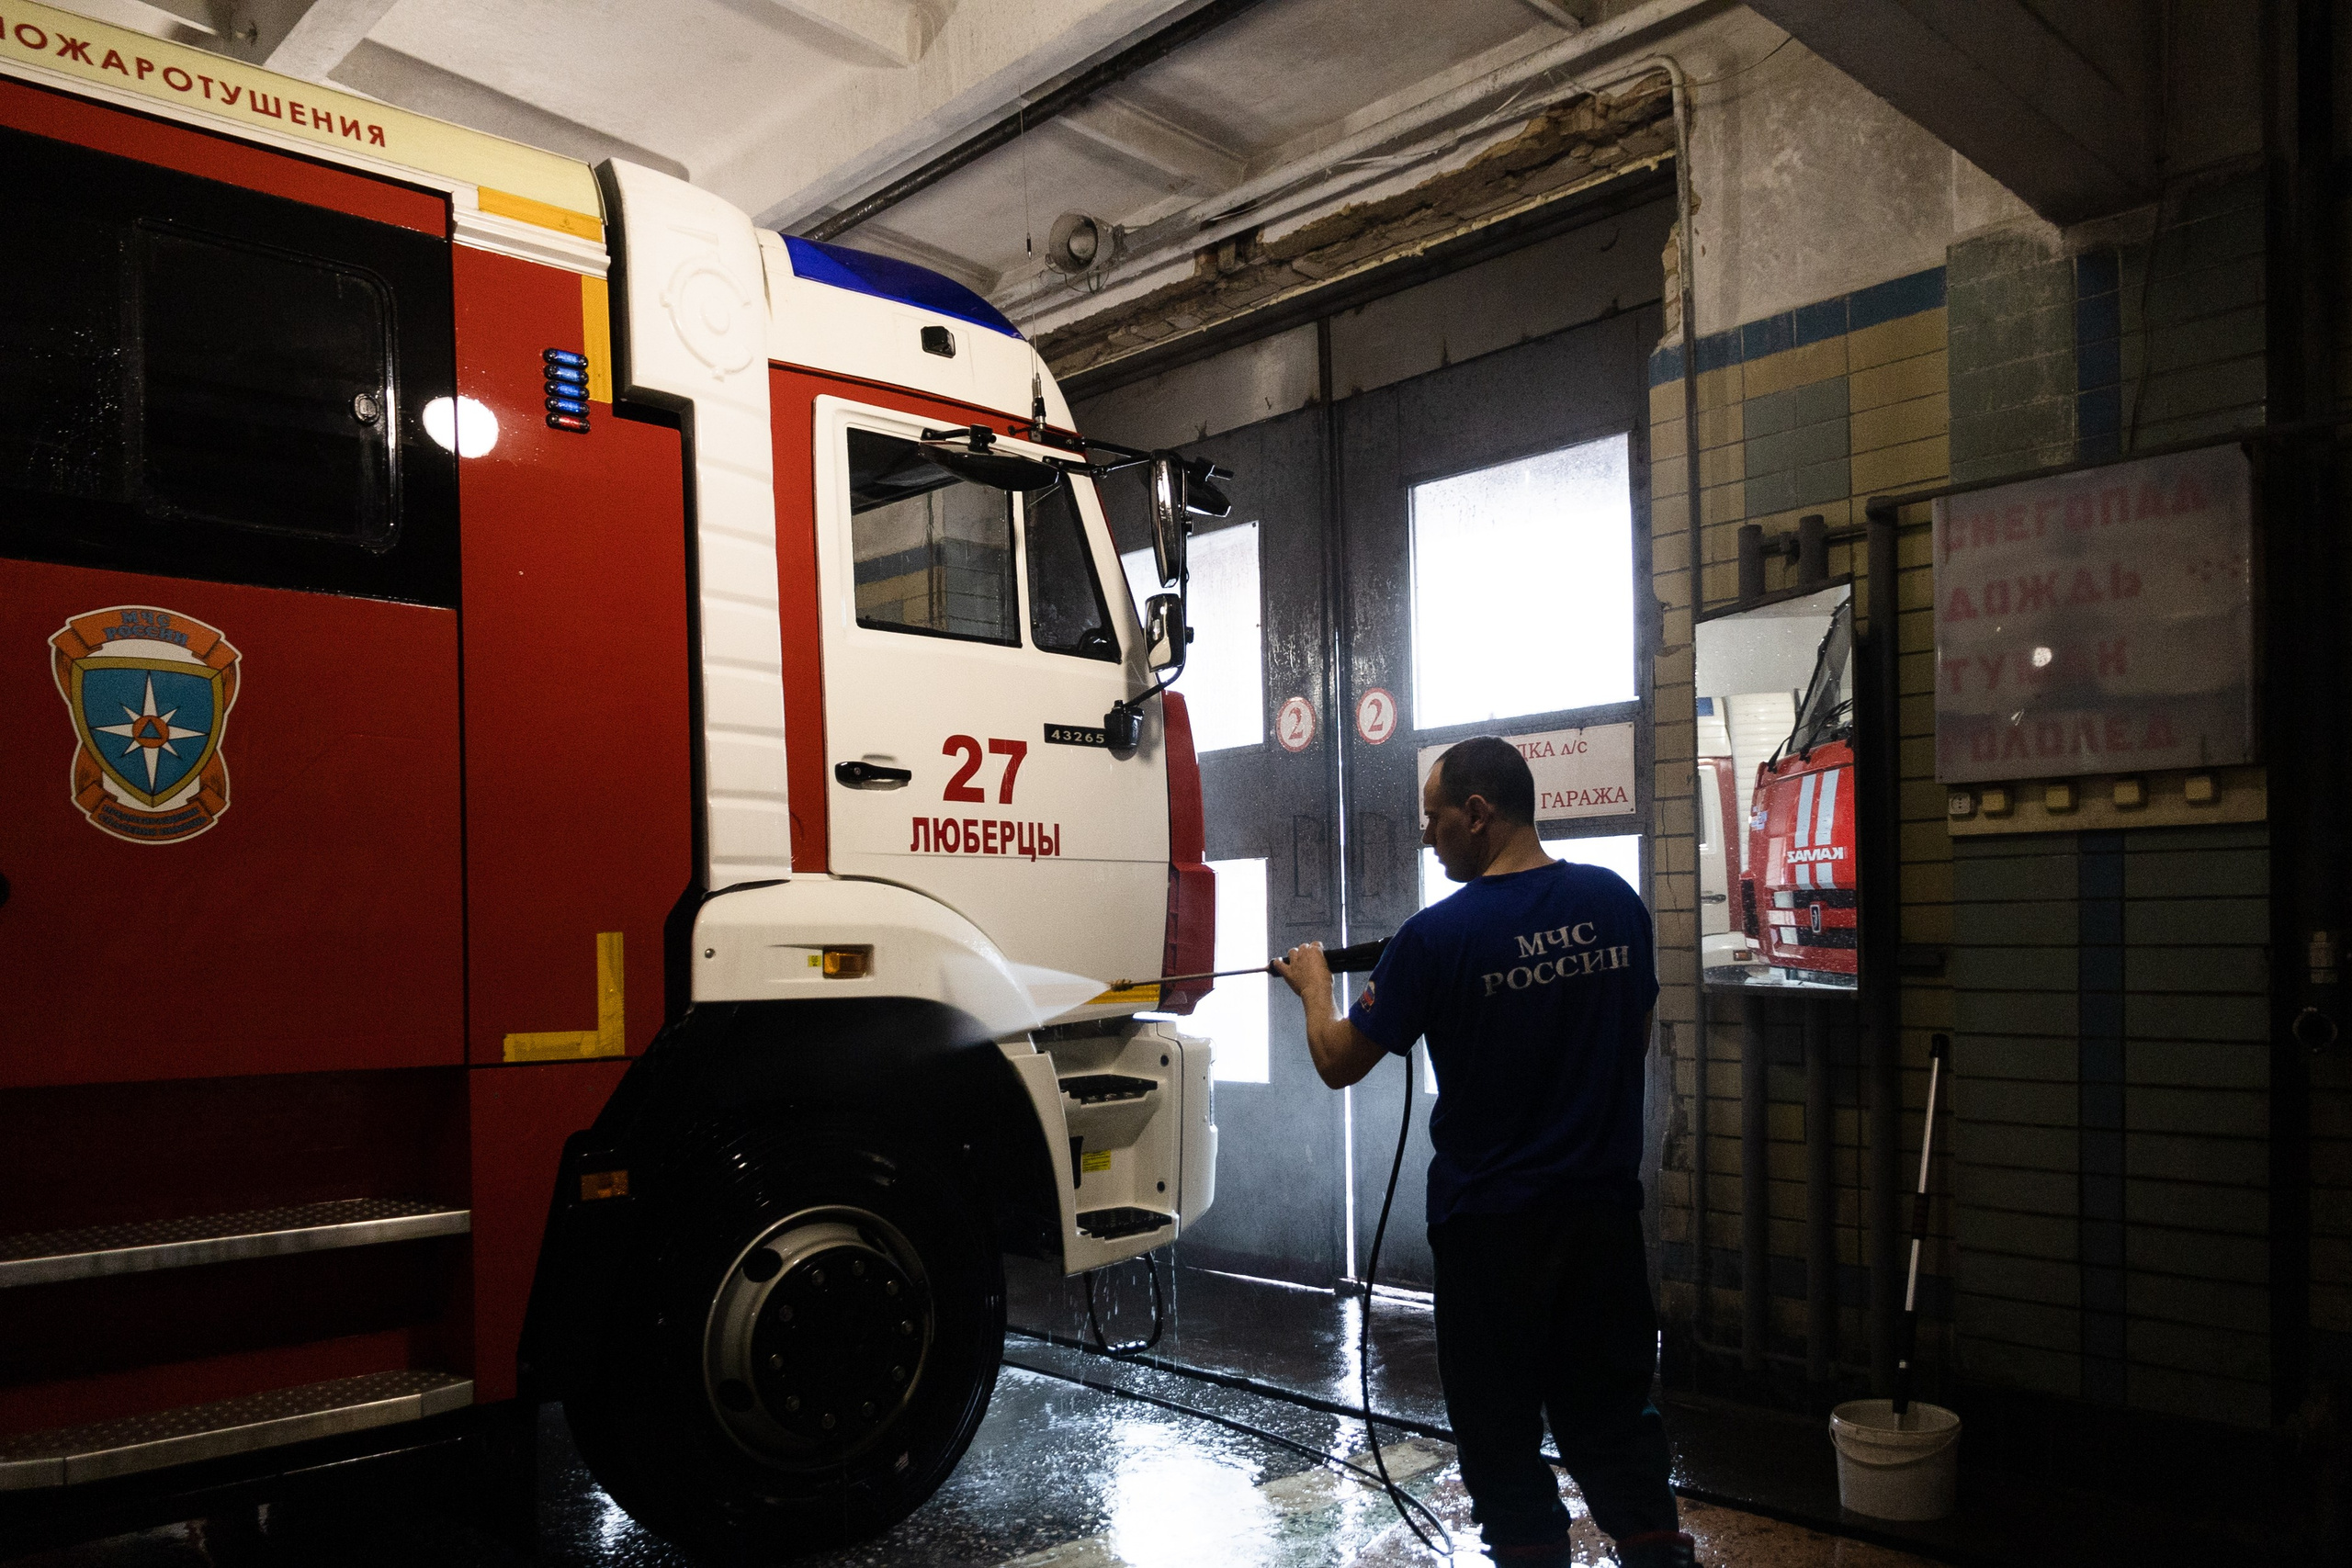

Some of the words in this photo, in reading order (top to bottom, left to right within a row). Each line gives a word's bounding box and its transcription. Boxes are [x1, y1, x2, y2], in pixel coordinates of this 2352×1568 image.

[0, 16, 387, 148] ОЖАРОТУШЕНИЯ
[1939, 473, 2208, 551] СНЕГОПАД
[1942, 561, 2143, 623] ДОЖДЬ
[104, 626, 189, 647] РОССИИ
[121, 610, 171, 627] МЧС
[1288, 706, 1304, 740] 2
[1368, 698, 1384, 732] 2
[1051, 728, 1105, 744] 43265
[942, 734, 1027, 805] 27
[1541, 786, 1628, 809] ГАРАЖА
[910, 817, 1060, 863] ЛЮБЕРЦЫ
[1514, 921, 1598, 959] МЧС
[1481, 945, 1631, 997] РОССИИ
